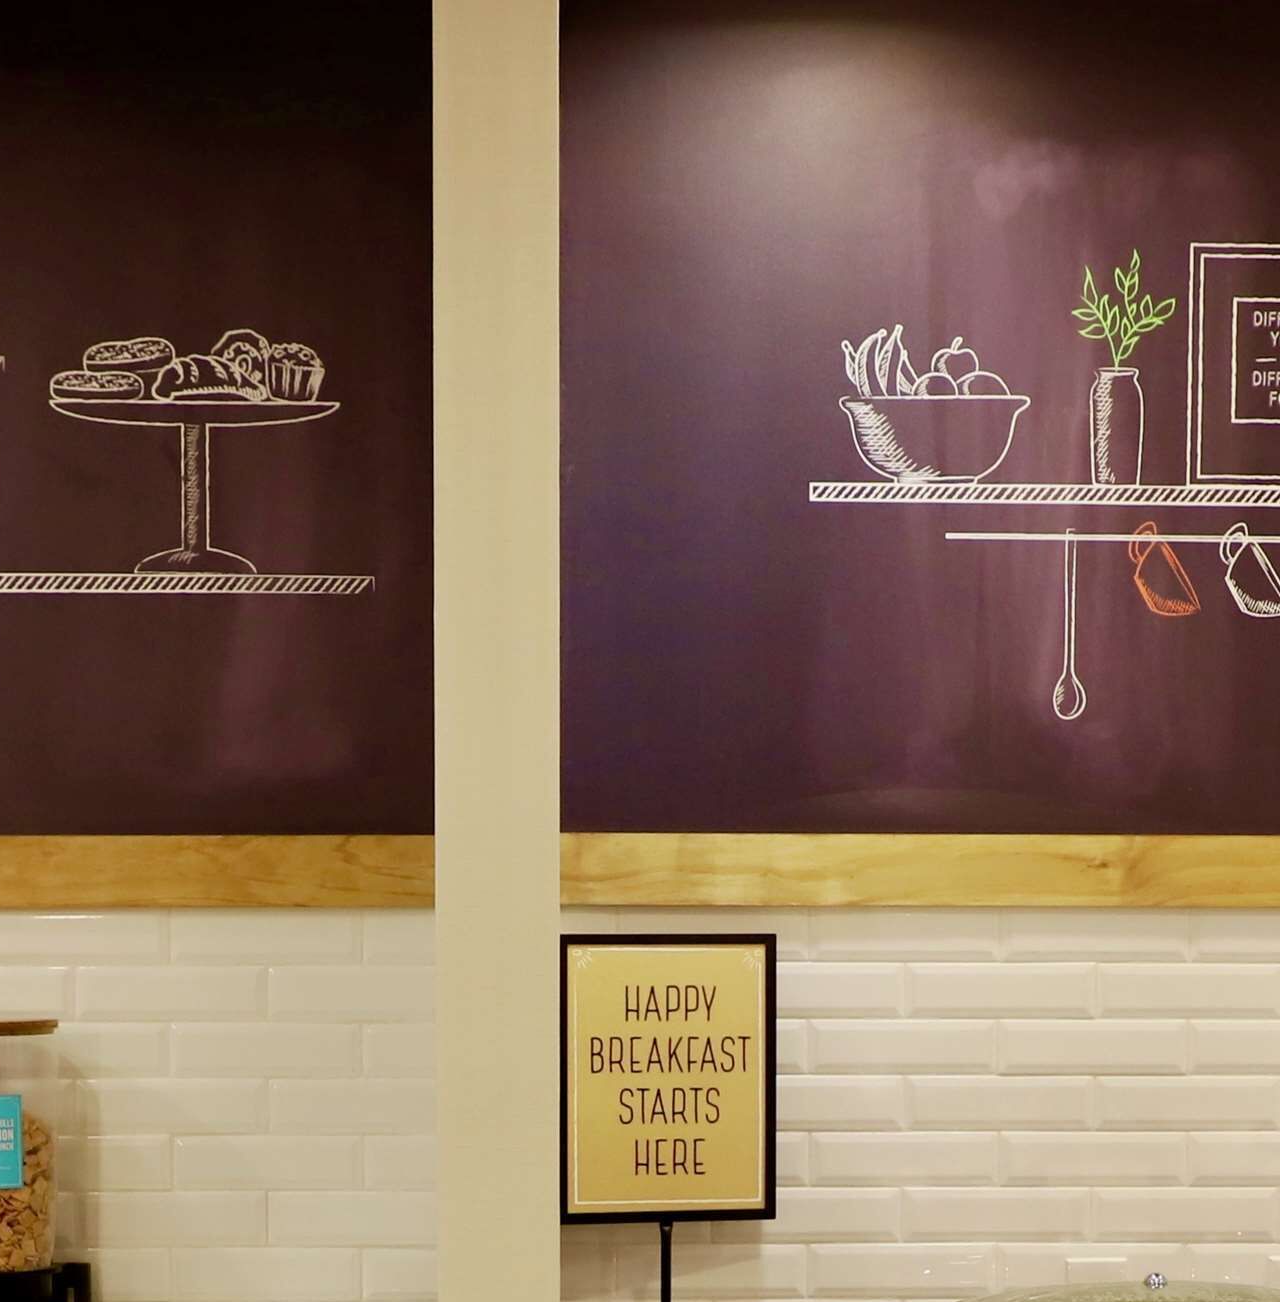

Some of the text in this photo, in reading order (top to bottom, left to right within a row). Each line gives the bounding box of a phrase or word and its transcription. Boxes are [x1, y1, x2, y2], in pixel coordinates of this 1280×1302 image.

[625, 985, 717, 1022] HAPPY
[589, 1036, 751, 1074] BREAKFAST
[619, 1087, 721, 1125] STARTS
[634, 1138, 706, 1176] HERE
